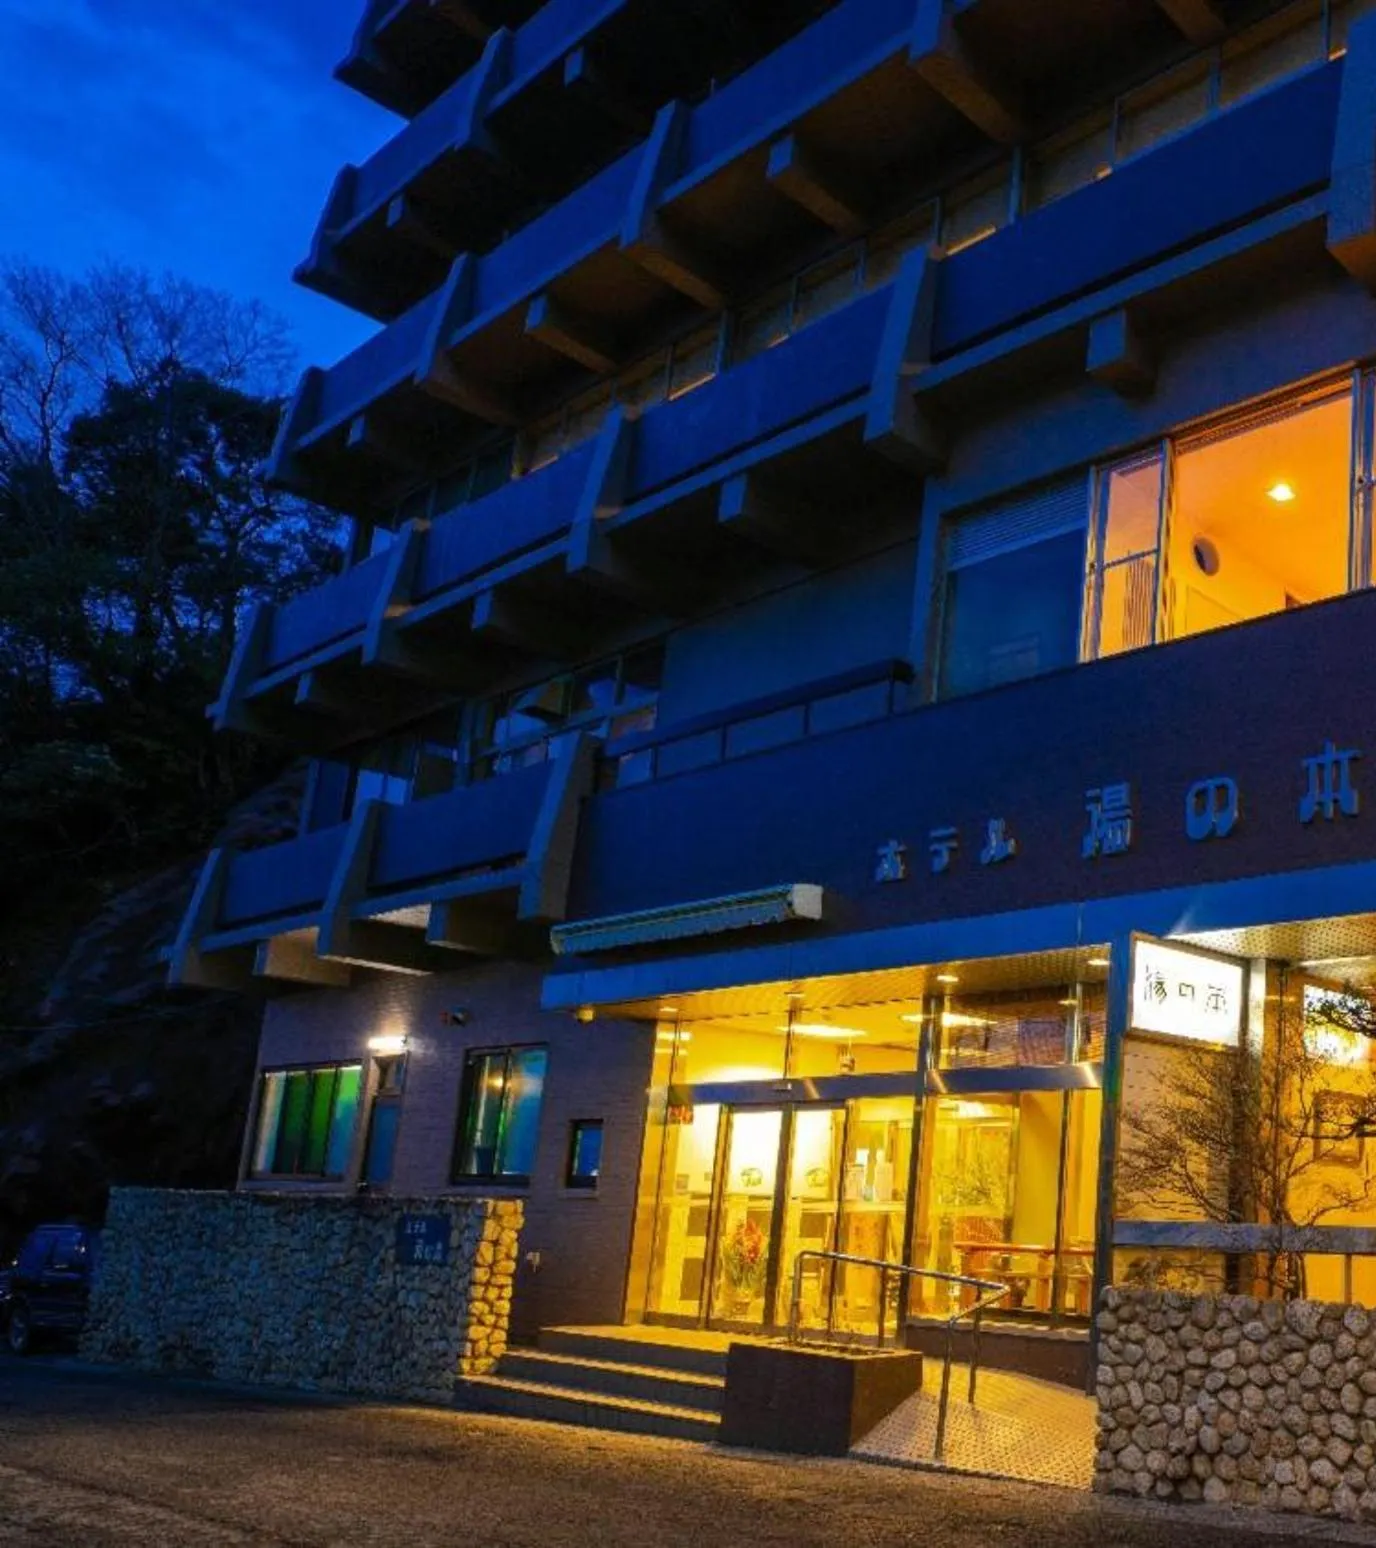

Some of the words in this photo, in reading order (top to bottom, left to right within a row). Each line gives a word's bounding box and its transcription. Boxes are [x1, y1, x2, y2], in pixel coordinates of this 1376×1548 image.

[875, 818, 1017, 882] ホテル
[1082, 740, 1363, 859] 湯の本
